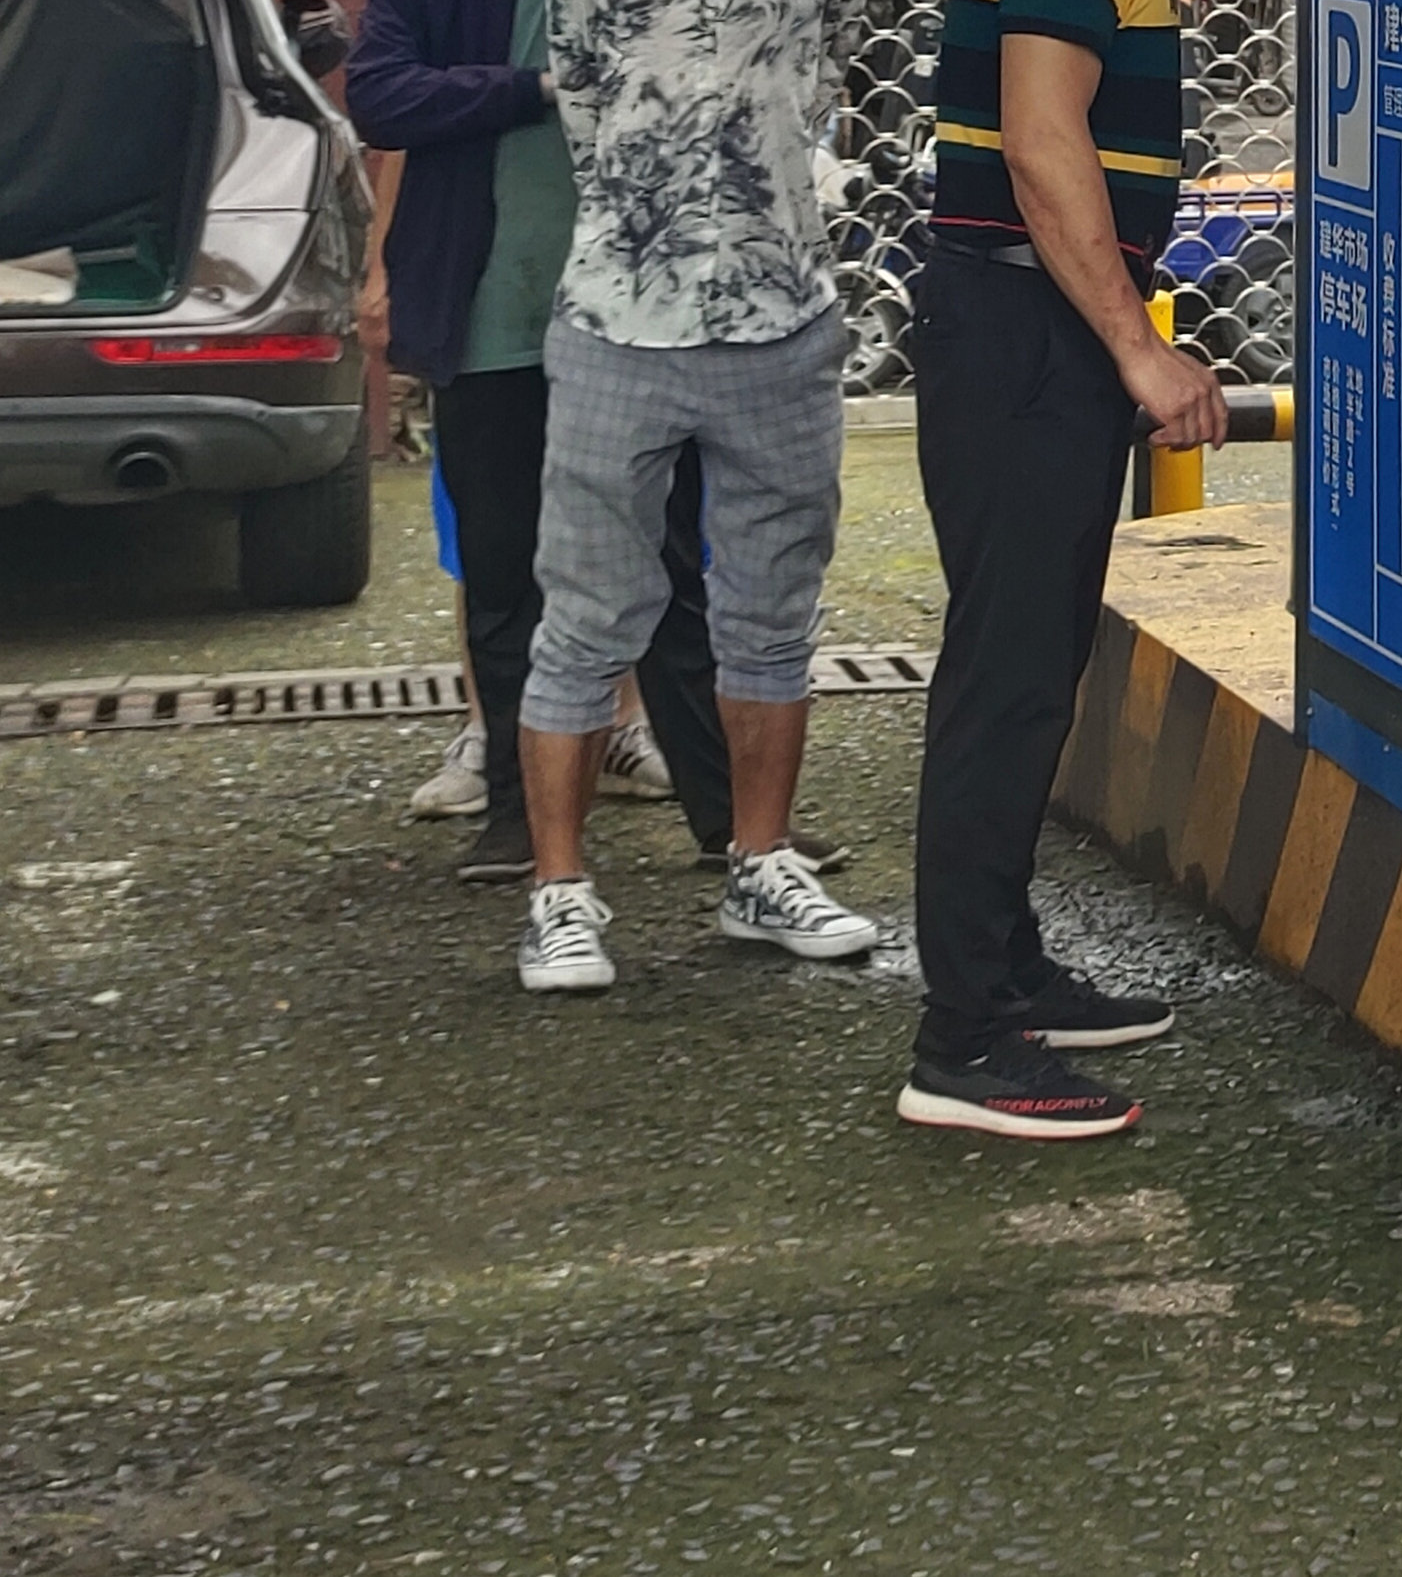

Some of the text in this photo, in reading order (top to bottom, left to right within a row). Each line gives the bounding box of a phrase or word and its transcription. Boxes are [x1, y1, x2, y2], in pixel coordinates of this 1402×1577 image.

[1319, 219, 1369, 272] 建华市场
[1319, 272, 1368, 339] 停车场
[1381, 233, 1396, 400] 收费标准
